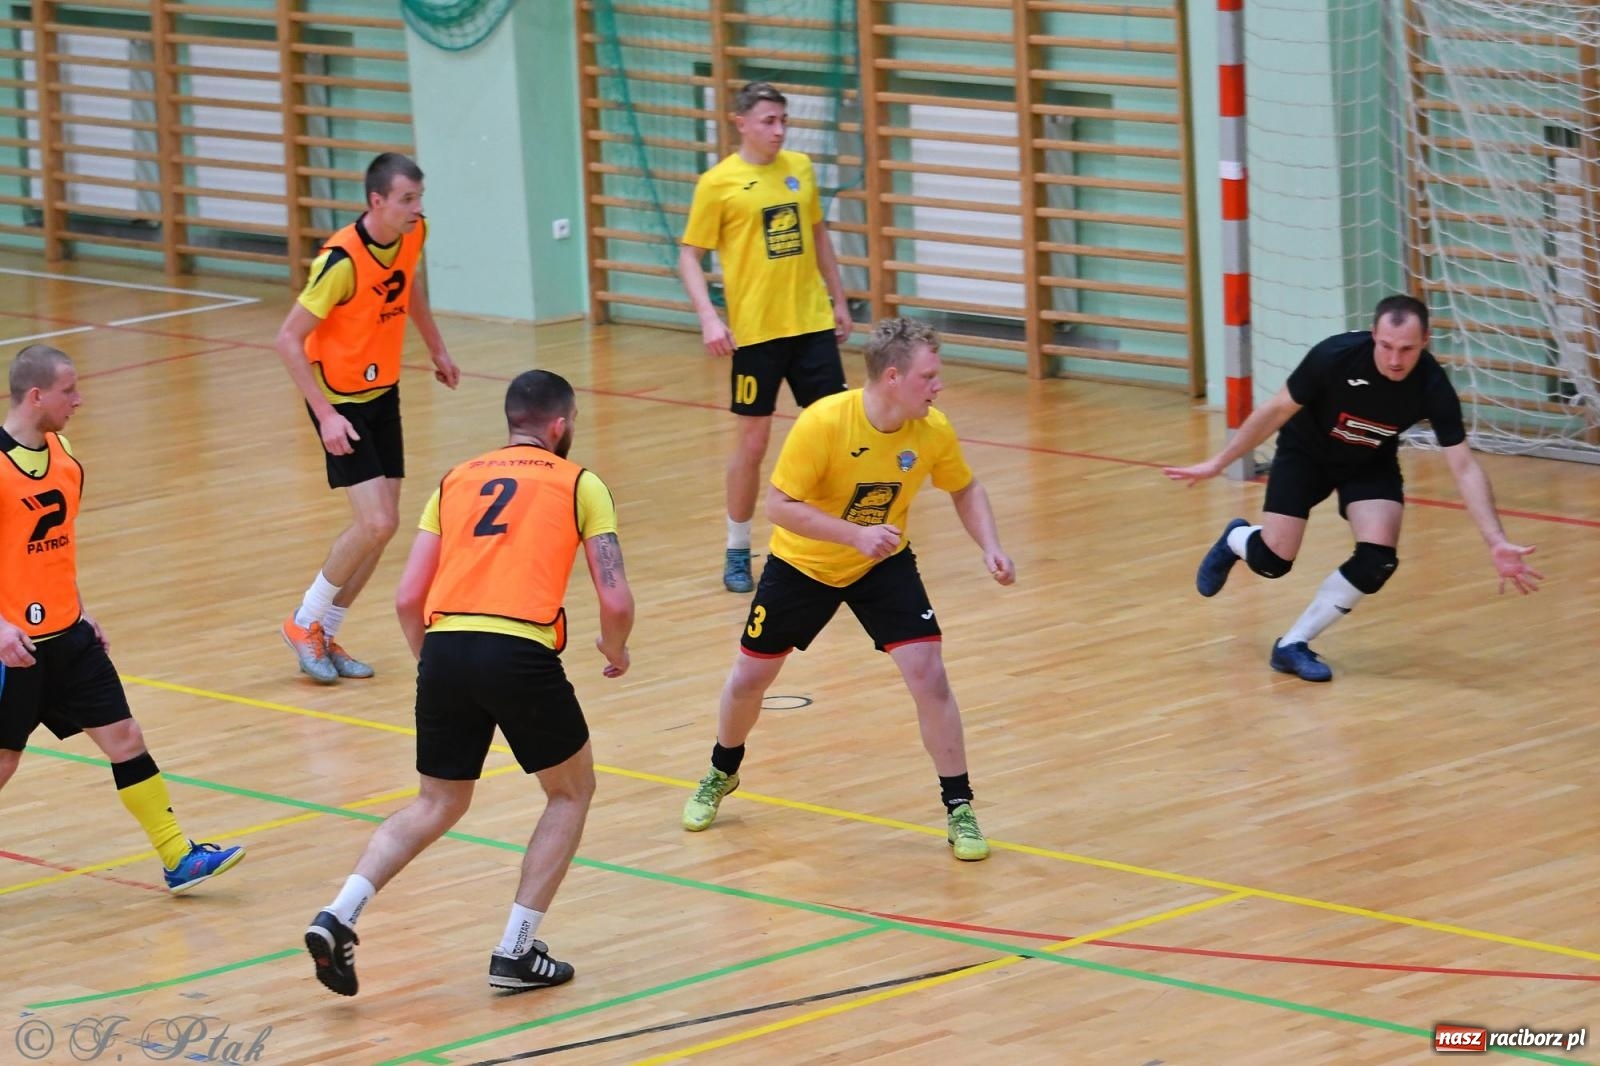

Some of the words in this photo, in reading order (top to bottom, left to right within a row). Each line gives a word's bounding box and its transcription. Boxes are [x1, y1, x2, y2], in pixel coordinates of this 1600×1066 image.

[735, 375, 757, 404] 10
[486, 459, 555, 469] PATRICK
[473, 477, 518, 537] 2
[30, 603, 42, 624] 6
[747, 605, 766, 638] 3
